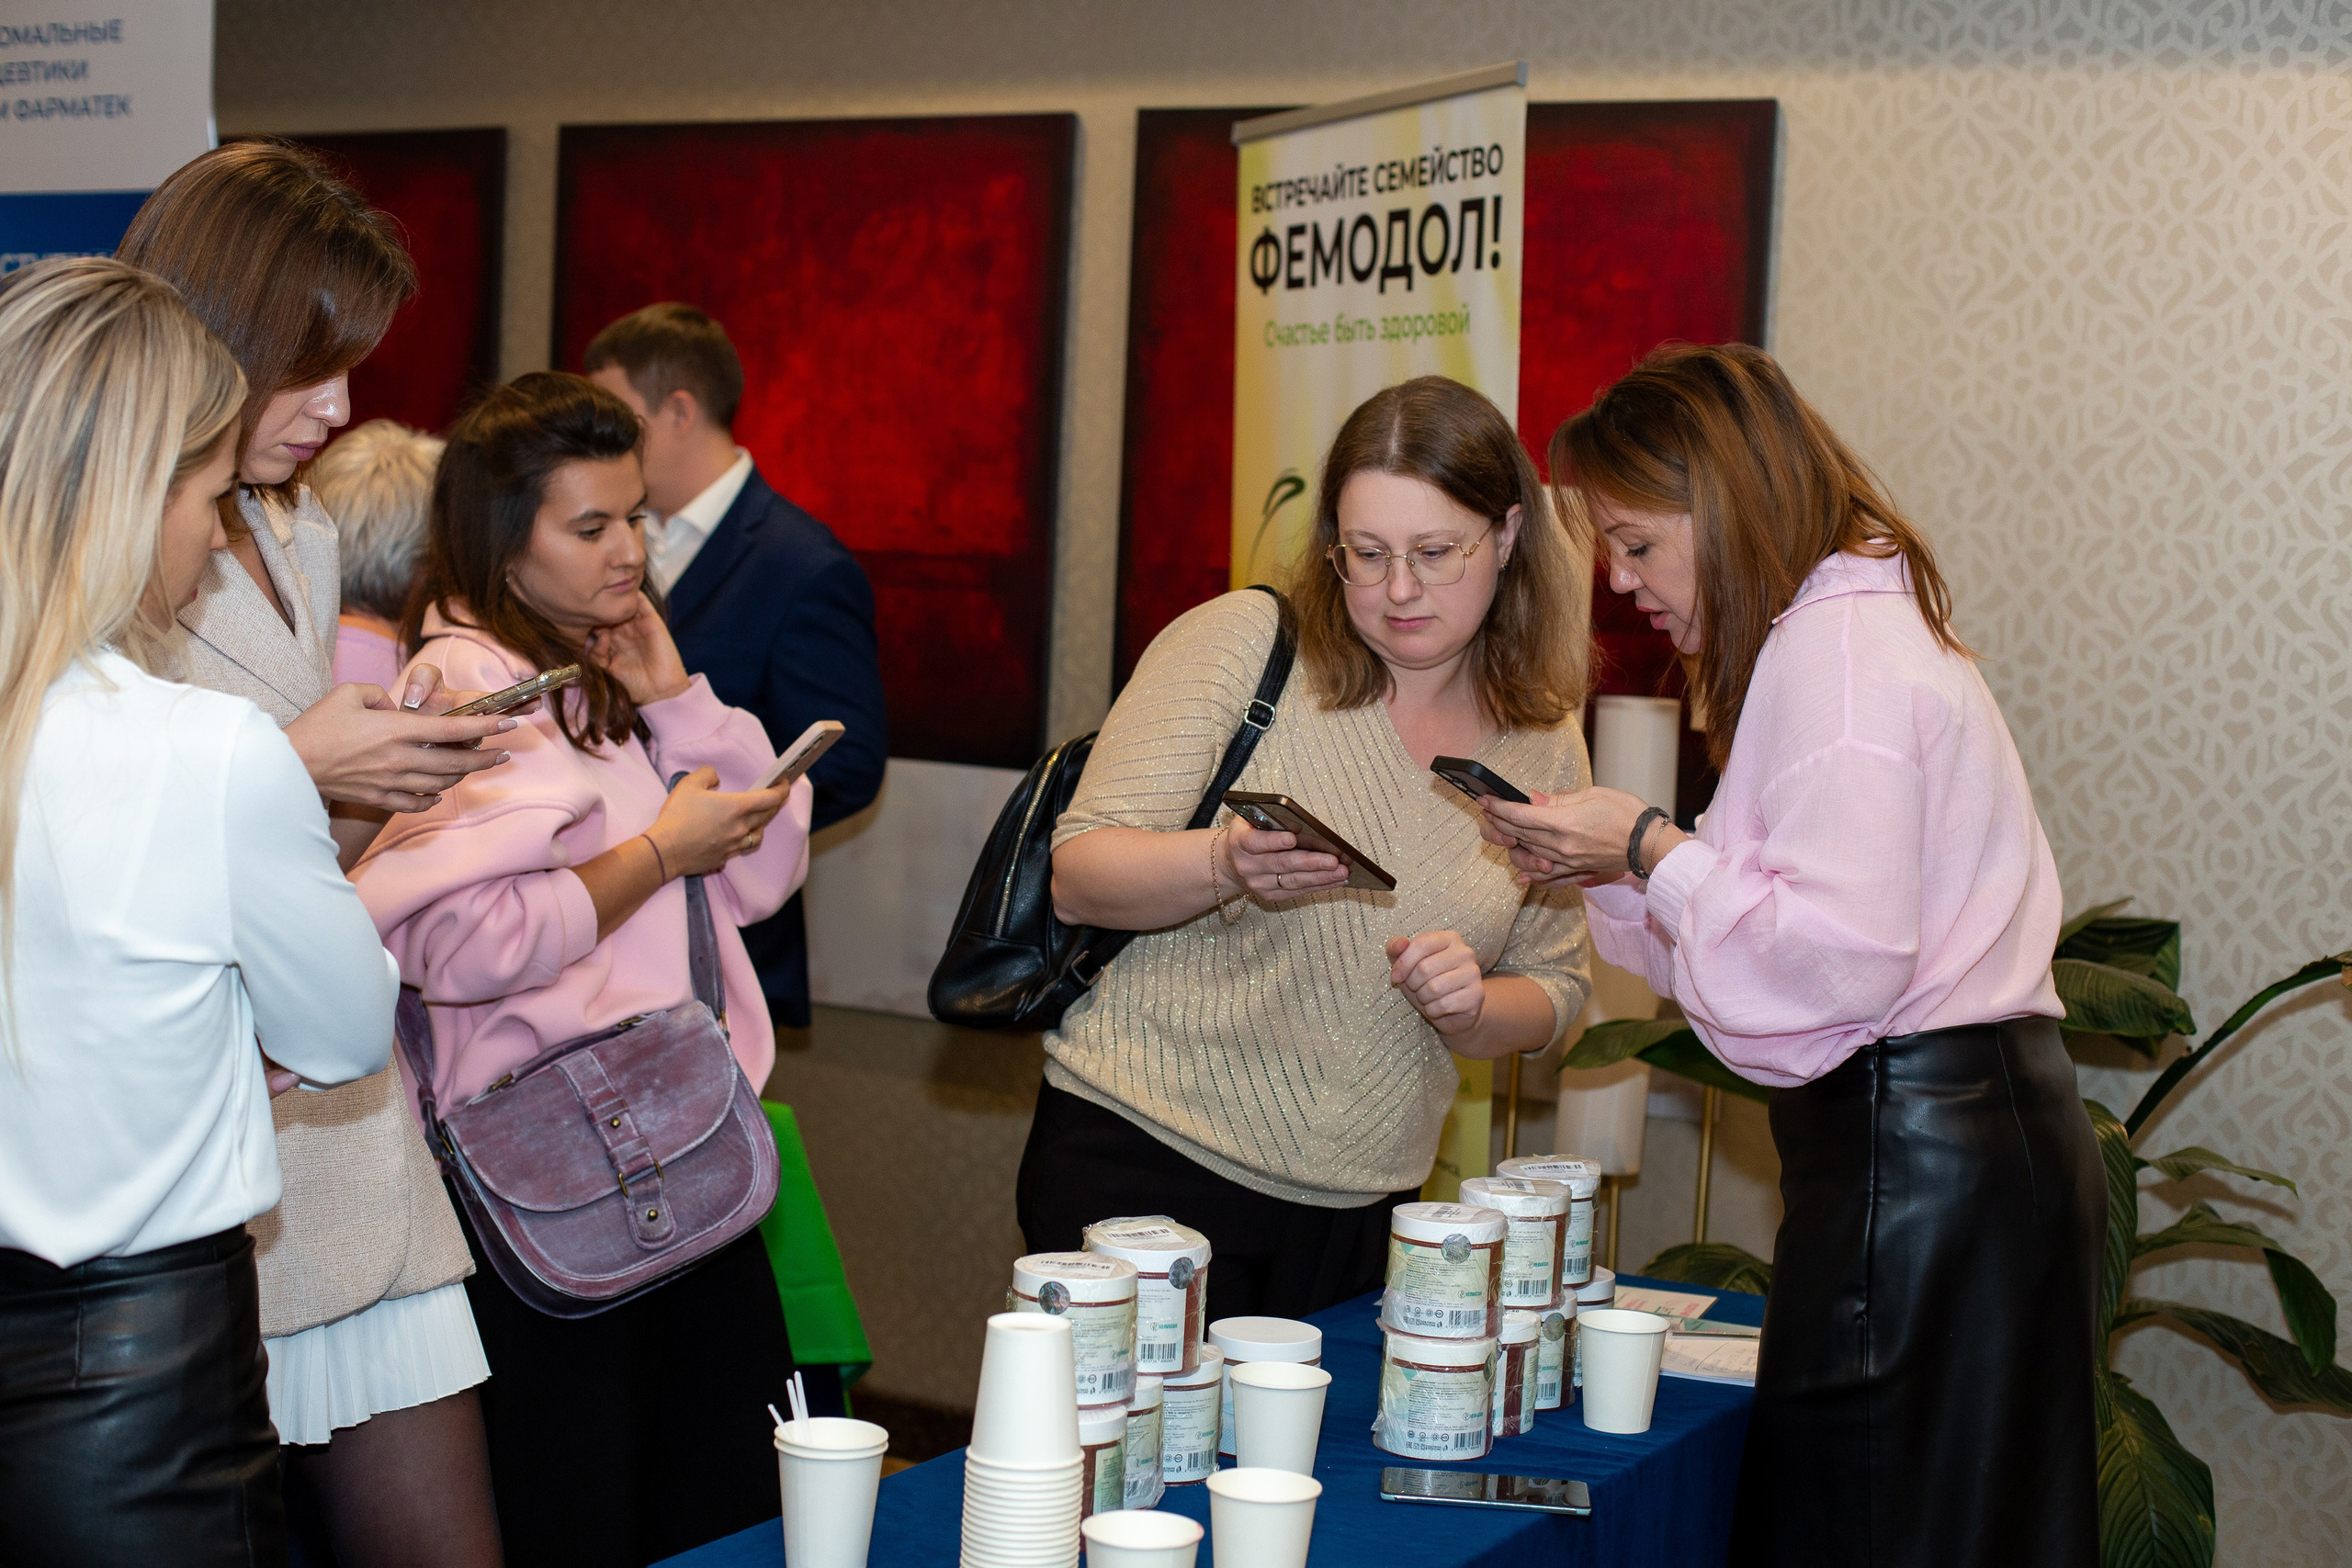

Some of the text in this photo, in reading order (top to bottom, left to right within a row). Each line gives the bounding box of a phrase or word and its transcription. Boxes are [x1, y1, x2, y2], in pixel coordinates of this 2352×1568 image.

[0, 59, 89, 85] ЕВТИКИ
[13, 94, 132, 121] ФАРМАТЕК
[1251, 143, 1504, 213] ВСТРЕЧАЙТЕ СЕМЕЙСТВО
[1250, 194, 1502, 296] ФЕМОДОЛ!
[1264, 303, 1471, 348] Счастье быть здоровой
